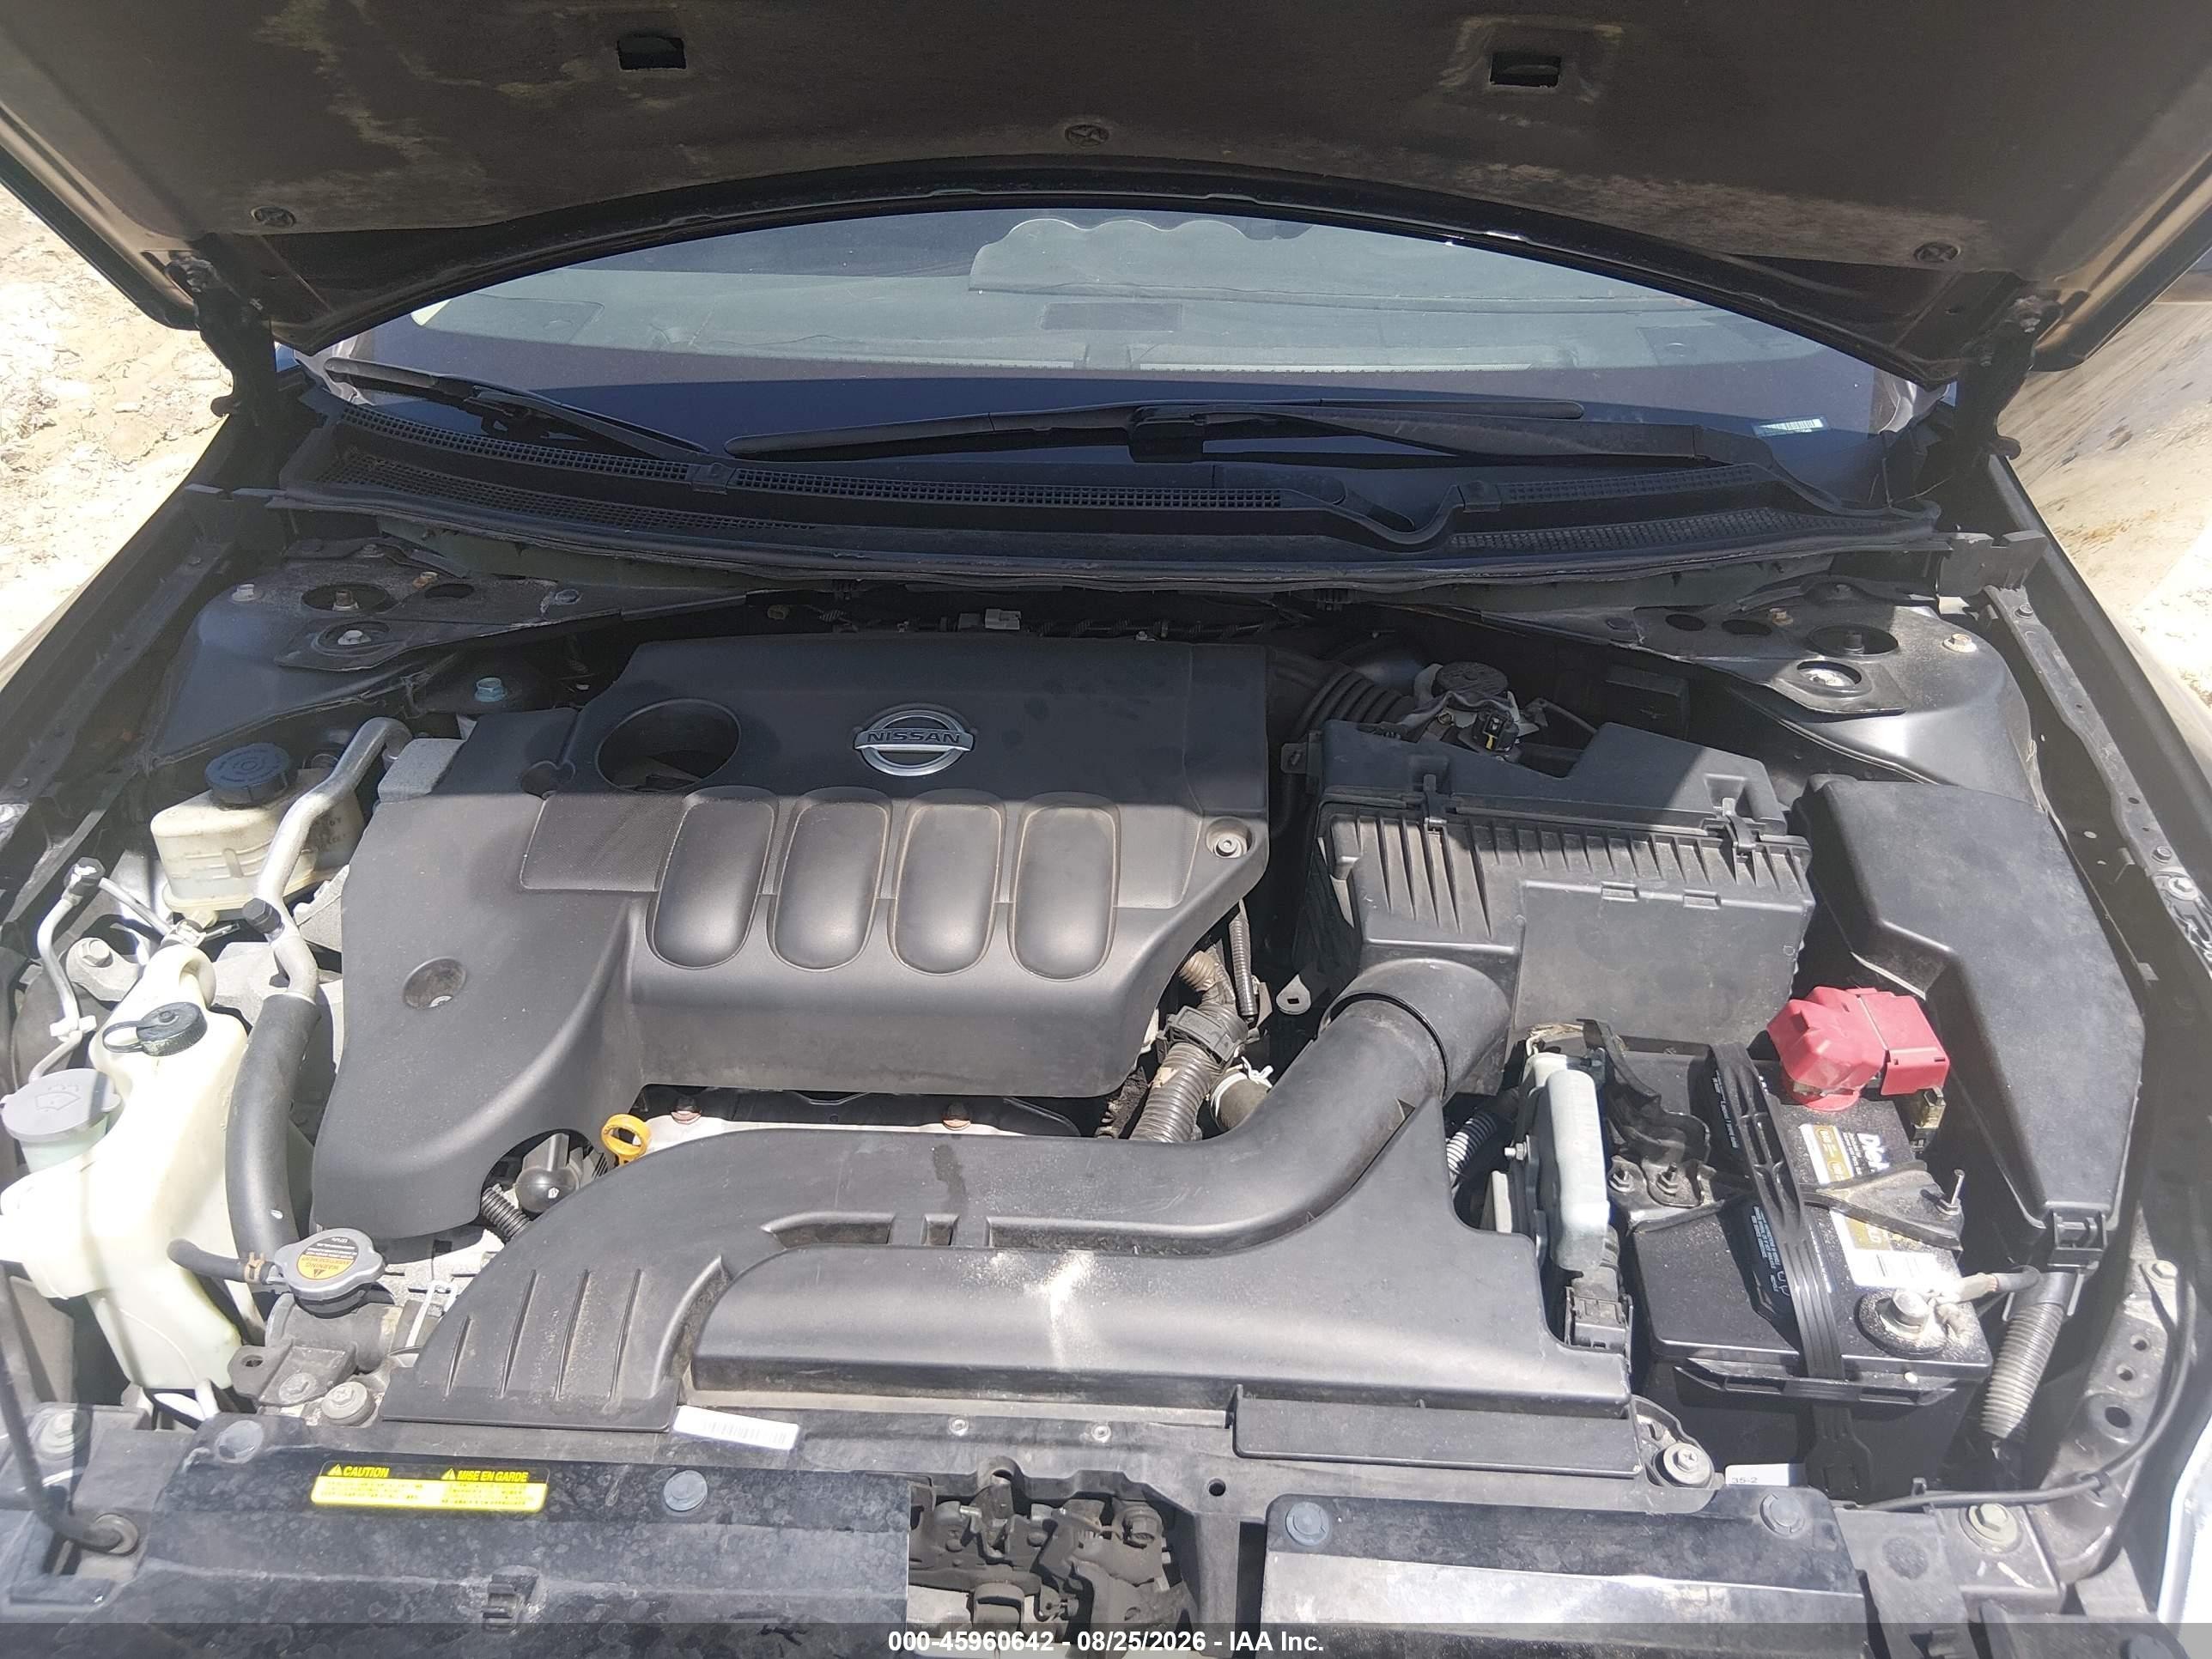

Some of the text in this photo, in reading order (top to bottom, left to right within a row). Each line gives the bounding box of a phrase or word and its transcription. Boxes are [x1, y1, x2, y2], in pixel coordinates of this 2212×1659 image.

[866, 731, 960, 744] NISSAN
[305, 1261, 339, 1270] WARNING
[343, 1466, 390, 1478] CAUTION
[457, 1470, 529, 1482] MISE EN GARDE
